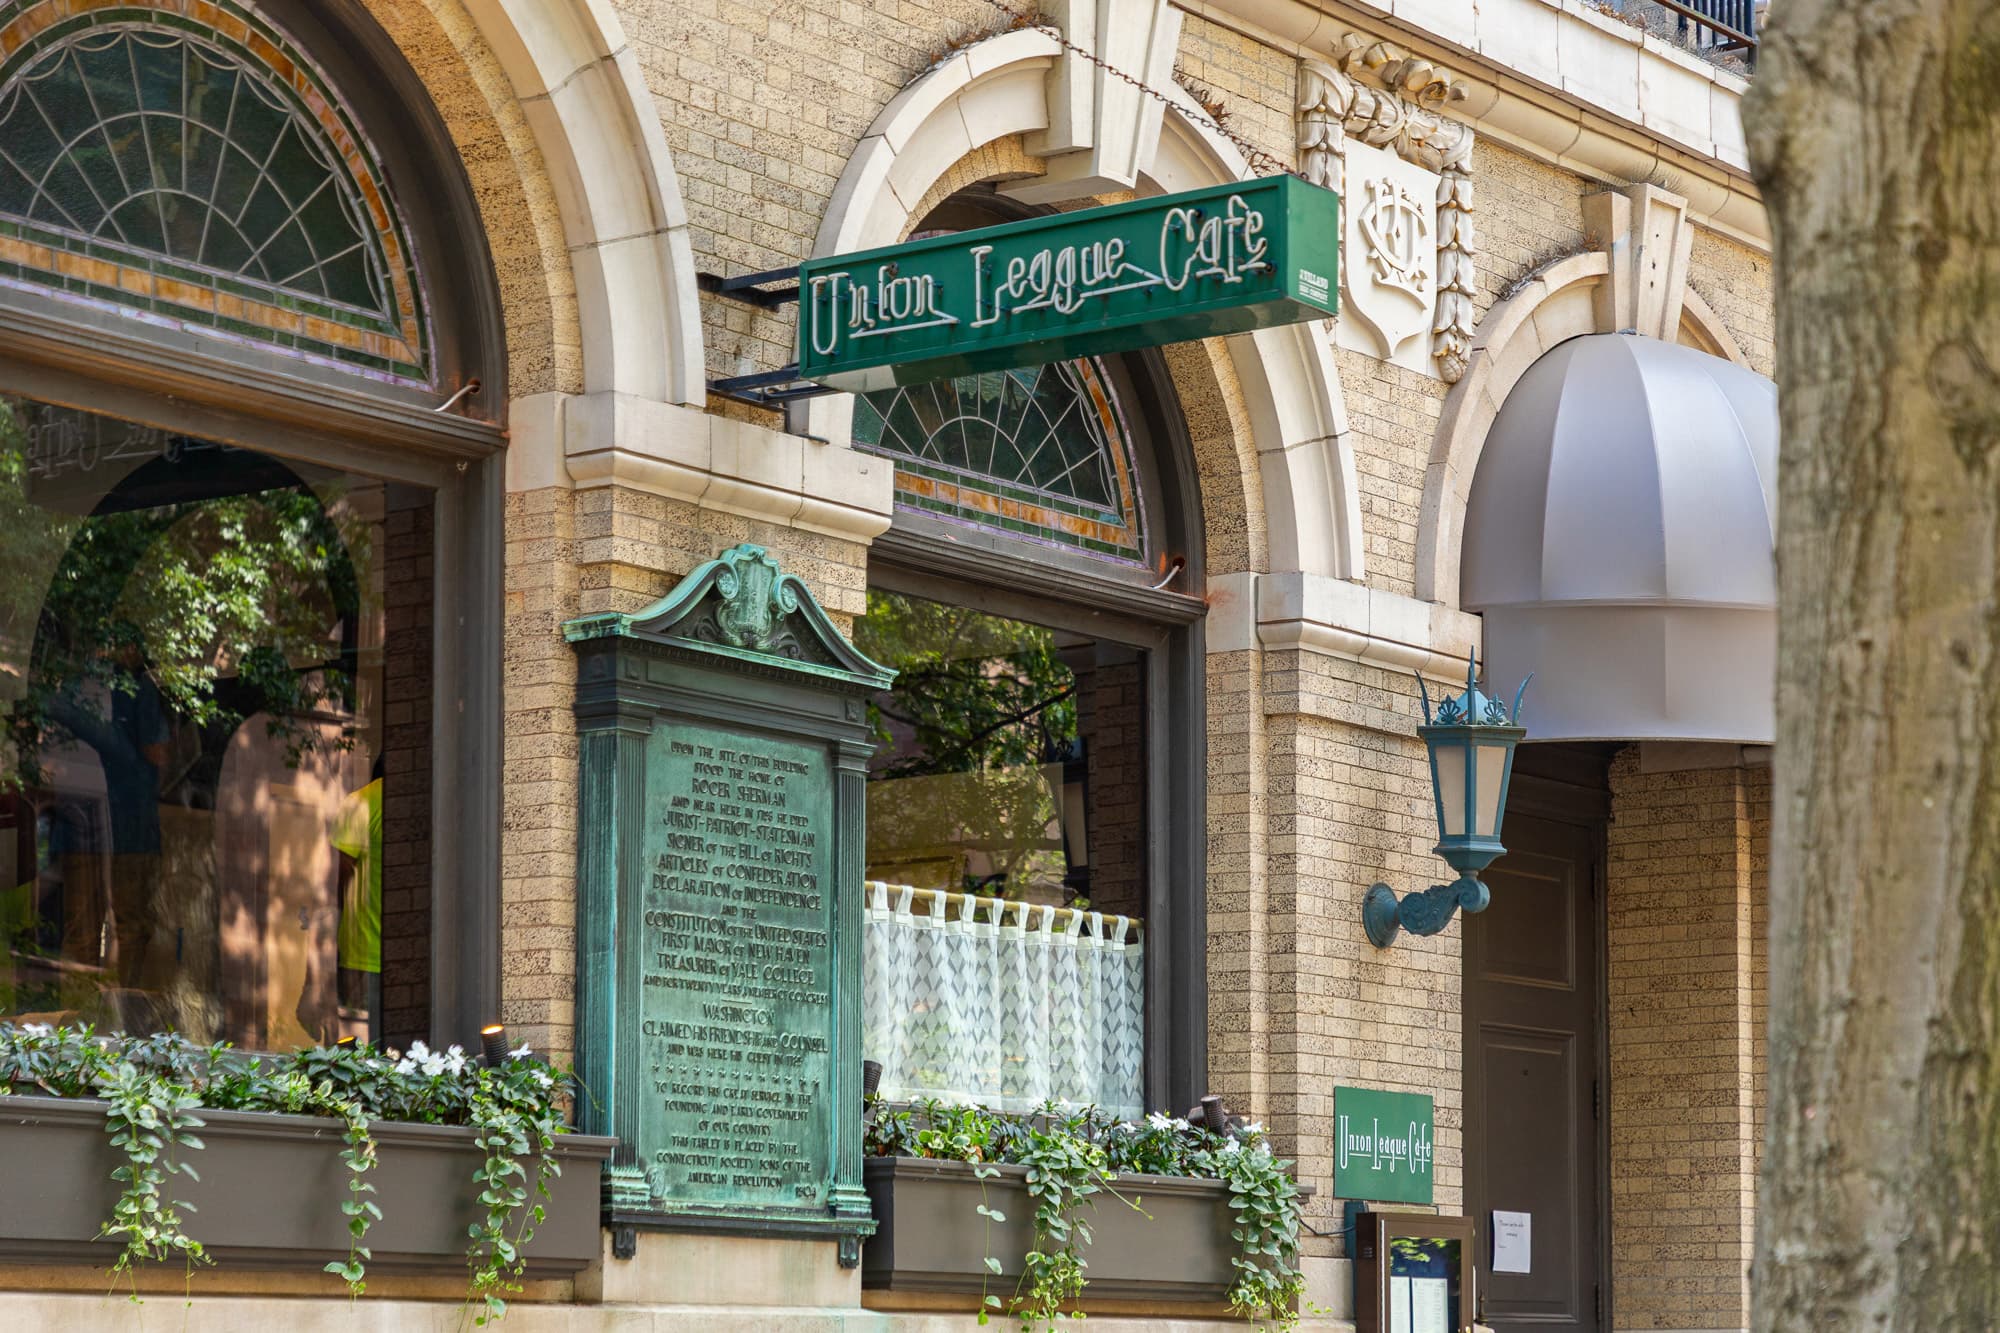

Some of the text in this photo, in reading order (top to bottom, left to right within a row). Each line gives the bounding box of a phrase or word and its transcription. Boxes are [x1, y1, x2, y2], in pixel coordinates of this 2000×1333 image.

[809, 263, 960, 356] Union
[969, 237, 1164, 329] League
[1159, 194, 1278, 292] Cafe
[671, 741, 809, 776] UPON THE SITE OF THIS BUILDING
[694, 762, 785, 787] STOOD THE HOME OF
[692, 778, 785, 808] ROGER SHERMAN
[671, 796, 689, 809] AND
[693, 799, 715, 813] NEAR
[720, 804, 741, 817] HERE
[745, 808, 753, 818] IN
[777, 813, 787, 824] HE
[790, 815, 808, 827] DIED
[667, 833, 812, 868] SIGNER OF THE BILL OF RIGHTS
[658, 853, 817, 890] ARTICLES OF CONFEDERATION
[653, 872, 821, 911] DECLARATION OF INDEPENDENCE
[720, 904, 757, 920] AND THE
[645, 910, 827, 948] CONSTITUTION OF THE UNITED STATES
[662, 932, 810, 965] FIRST MAYOR OF NEW HAVEN
[656, 952, 815, 985] TREASURER OF YALE COLLEGE
[643, 974, 662, 987] AND
[663, 976, 679, 989] FOR
[679, 978, 715, 994] TWENTY
[716, 983, 742, 997] YEARS
[702, 1002, 775, 1026] WASHINGTON
[642, 1020, 828, 1053] CLAIMED HIS FRIENDSHIP AND COUNSEL
[666, 1044, 684, 1056] AND
[687, 1046, 704, 1058] WAS
[707, 1048, 728, 1061] HERE
[730, 1050, 742, 1062] HIS
[747, 1051, 772, 1065] GUEST
[774, 1054, 783, 1065] IN
[654, 1080, 813, 1105] TO RECORD HIS GREAT SERVICE IN THE
[664, 1099, 808, 1122] FOUNDING AND EARLY GOVERNMENT
[698, 1119, 772, 1137] OF OUR COUNTRY
[672, 1136, 799, 1156] THIS TABLET IS PLACED BY THE
[1340, 1115, 1431, 1174] Union League Cafe
[656, 1151, 812, 1174] CONNECTICUT SOCIETY SONS OF THE
[687, 1172, 783, 1189] AMERICAN REVOLUTION
